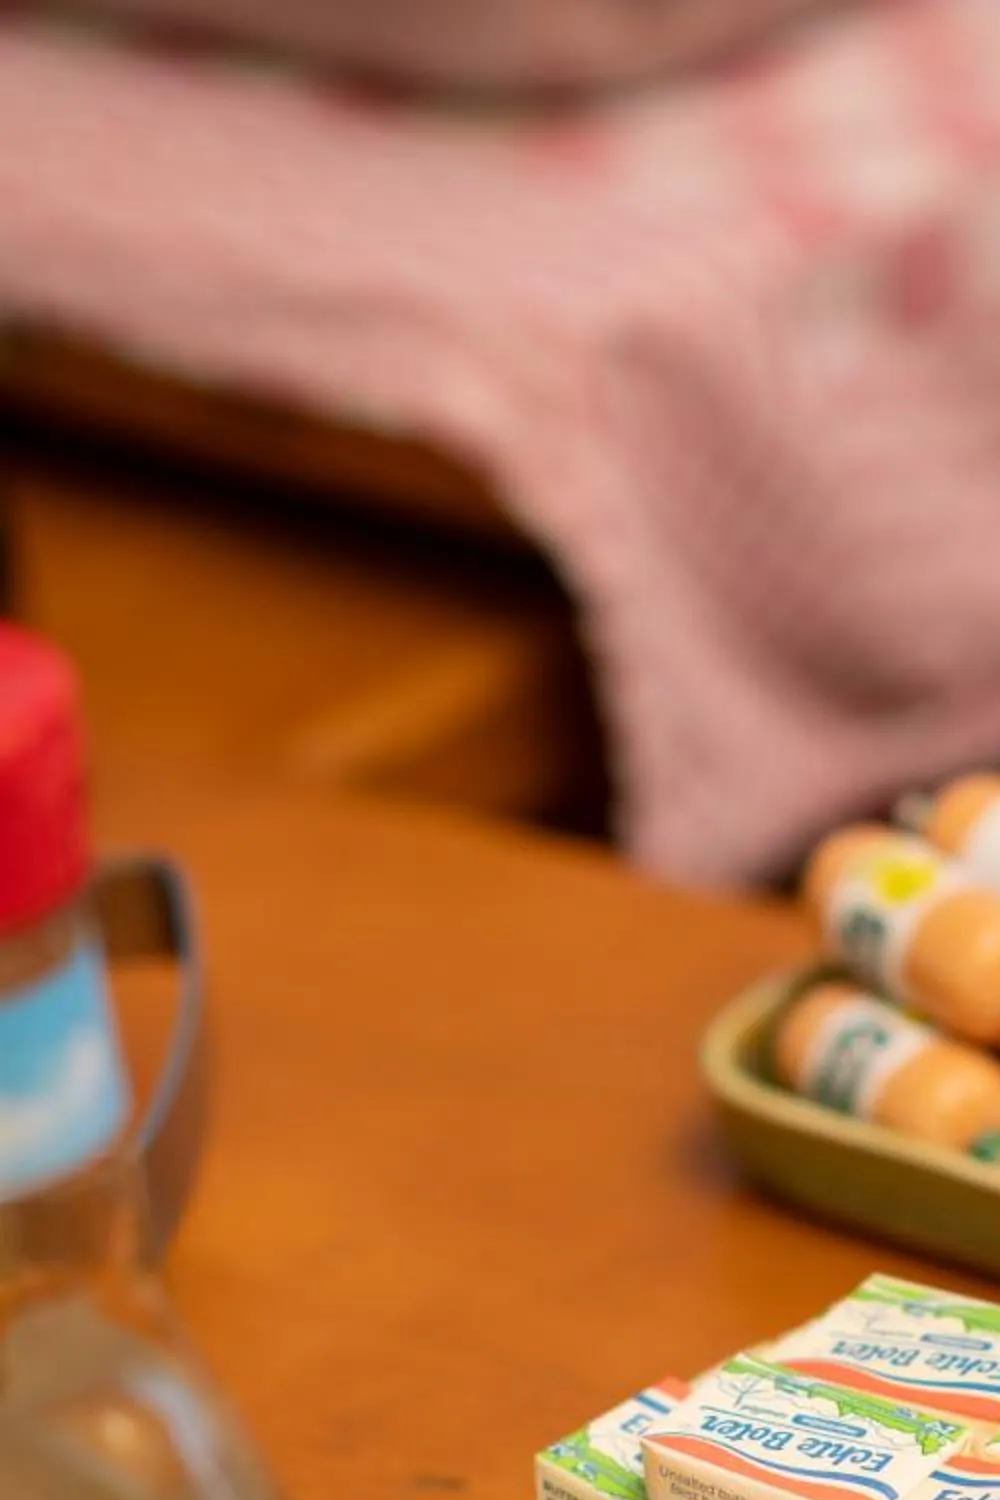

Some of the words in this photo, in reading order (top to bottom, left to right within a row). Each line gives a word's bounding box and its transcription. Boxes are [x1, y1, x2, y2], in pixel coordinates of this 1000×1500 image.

[831, 1340, 921, 1367] Boter
[700, 1414, 795, 1451] Boter
[797, 1436, 895, 1473] Echte
